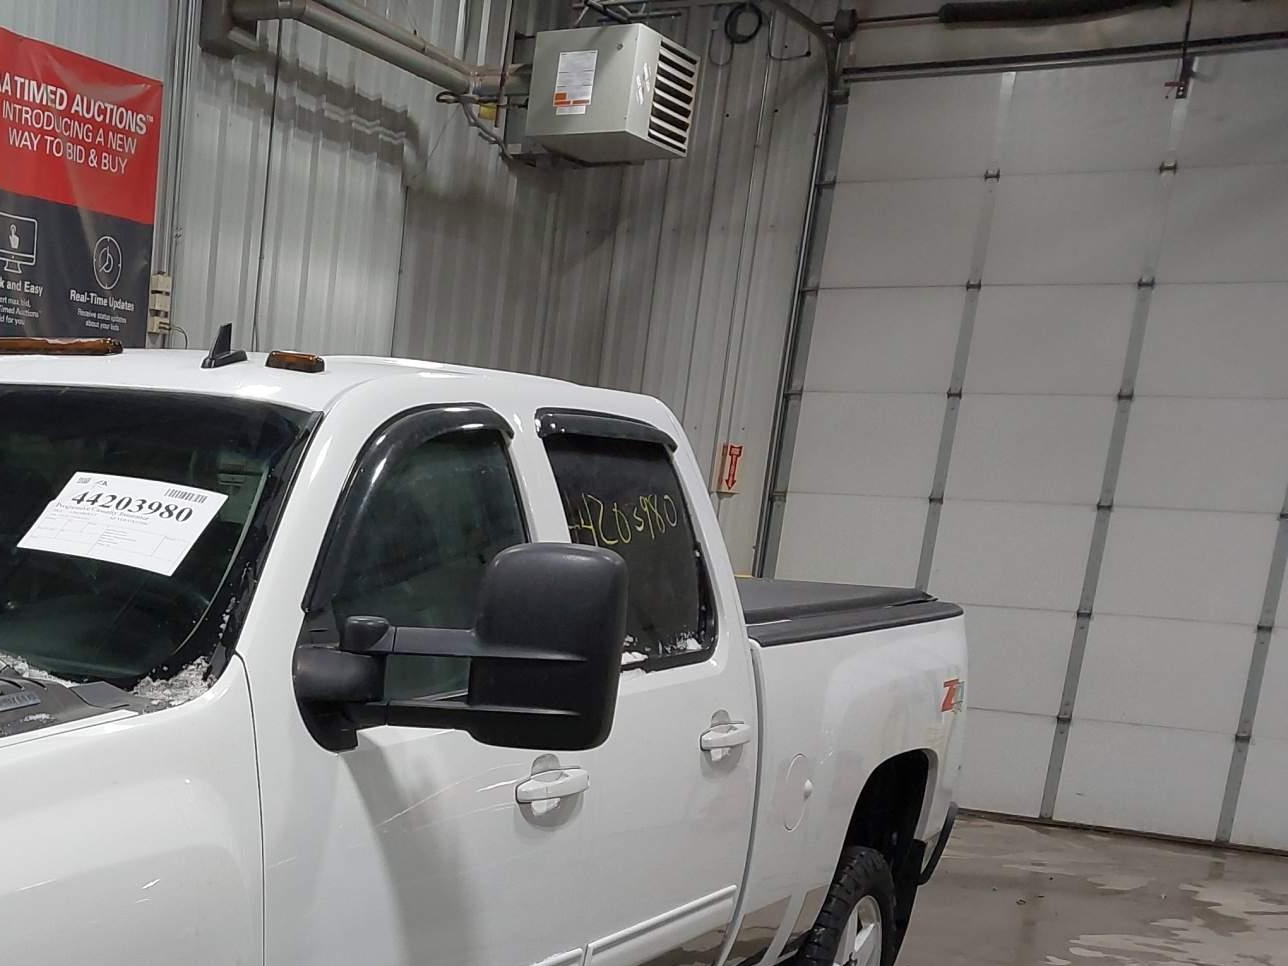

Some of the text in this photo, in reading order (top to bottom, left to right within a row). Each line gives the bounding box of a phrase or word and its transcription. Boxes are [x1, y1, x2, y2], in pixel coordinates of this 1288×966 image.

[14, 76, 68, 111] TIMED
[2, 100, 137, 155] INTRODUCING A NEW
[8, 127, 128, 175] WAY TO BID & BUY
[6, 279, 22, 292] and
[23, 281, 44, 297] Easy
[70, 289, 135, 312] Real-Time Updates
[71, 490, 193, 523] 44203980
